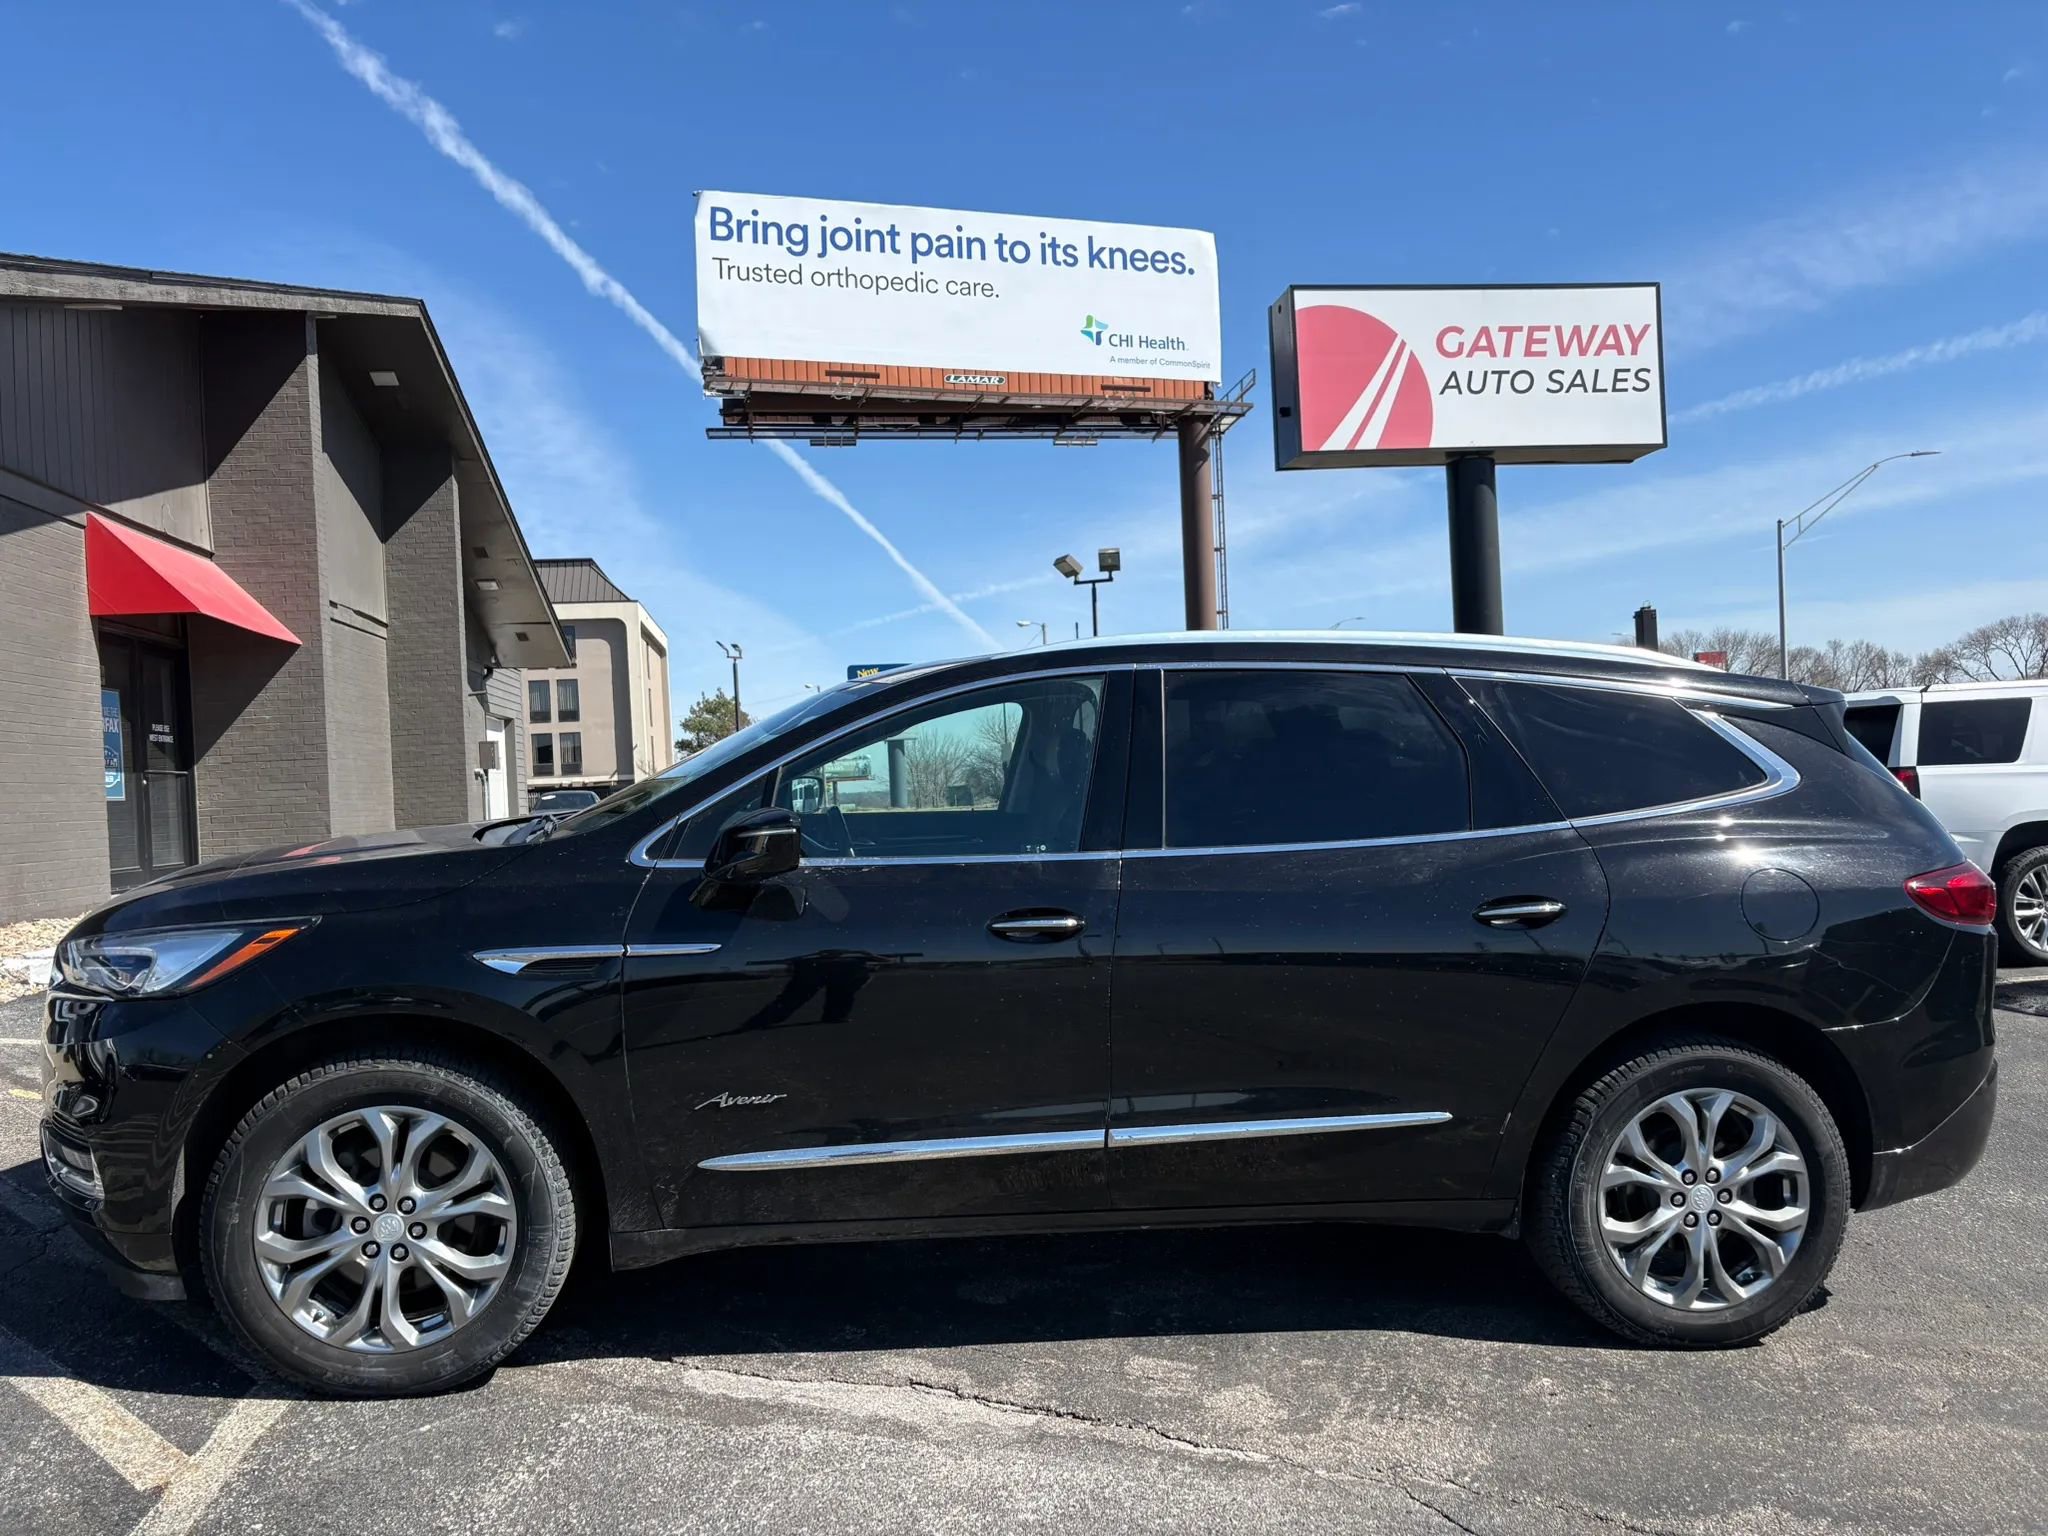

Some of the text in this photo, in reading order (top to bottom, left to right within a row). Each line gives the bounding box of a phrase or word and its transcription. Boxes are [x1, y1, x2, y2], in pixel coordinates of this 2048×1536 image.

[709, 206, 1195, 275] Bring joint pain to its knees.
[713, 257, 1000, 299] Trusted orthopedic care.
[1108, 333, 1185, 351] CHI Health
[1435, 323, 1651, 359] GATEWAY
[1110, 356, 1211, 369] A member of CommonSpirit
[950, 374, 999, 384] LAMAR
[1439, 367, 1651, 395] AUTO SALES
[694, 1091, 787, 1110] Avenir
